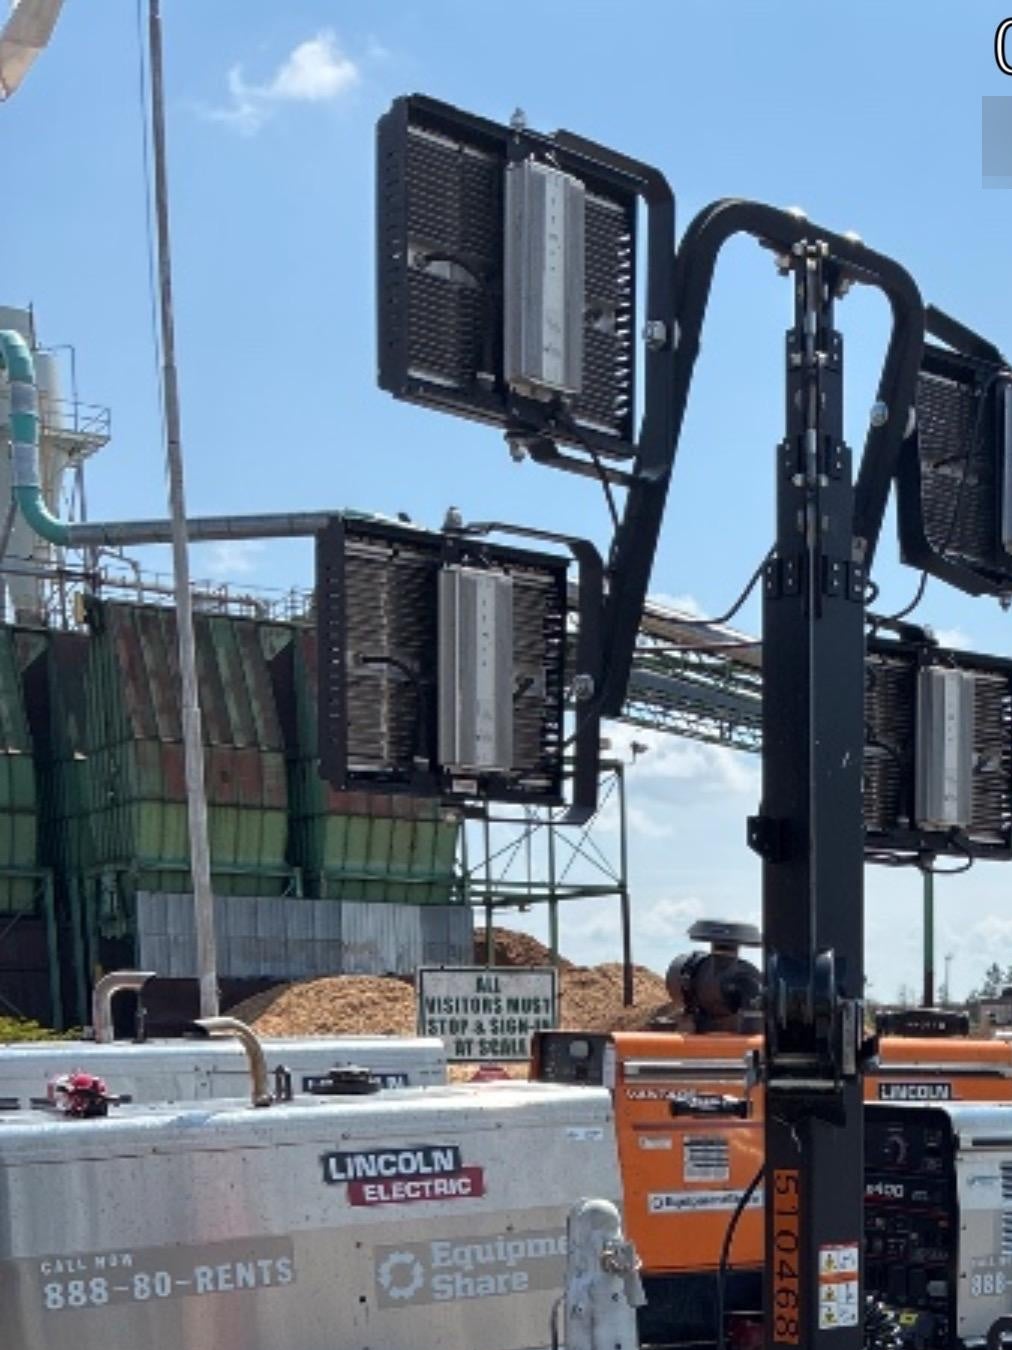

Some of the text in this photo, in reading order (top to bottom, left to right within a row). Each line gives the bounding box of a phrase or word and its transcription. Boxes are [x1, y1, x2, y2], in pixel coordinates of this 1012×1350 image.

[475, 976, 501, 993] ALL
[424, 997, 550, 1014] VISITORS MUST
[427, 1017, 469, 1035] STOP
[474, 1020, 486, 1035] &
[454, 1038, 527, 1056] AT SCALE
[880, 1085, 950, 1099] LINCOLN
[328, 1149, 455, 1181] LINCOLN
[362, 1177, 472, 1202] ELECTRIC
[775, 1174, 799, 1338] 510468
[40, 1258, 87, 1276] CALL
[43, 1256, 293, 1311] 888-80-RENTS
[431, 1271, 529, 1299] Share
